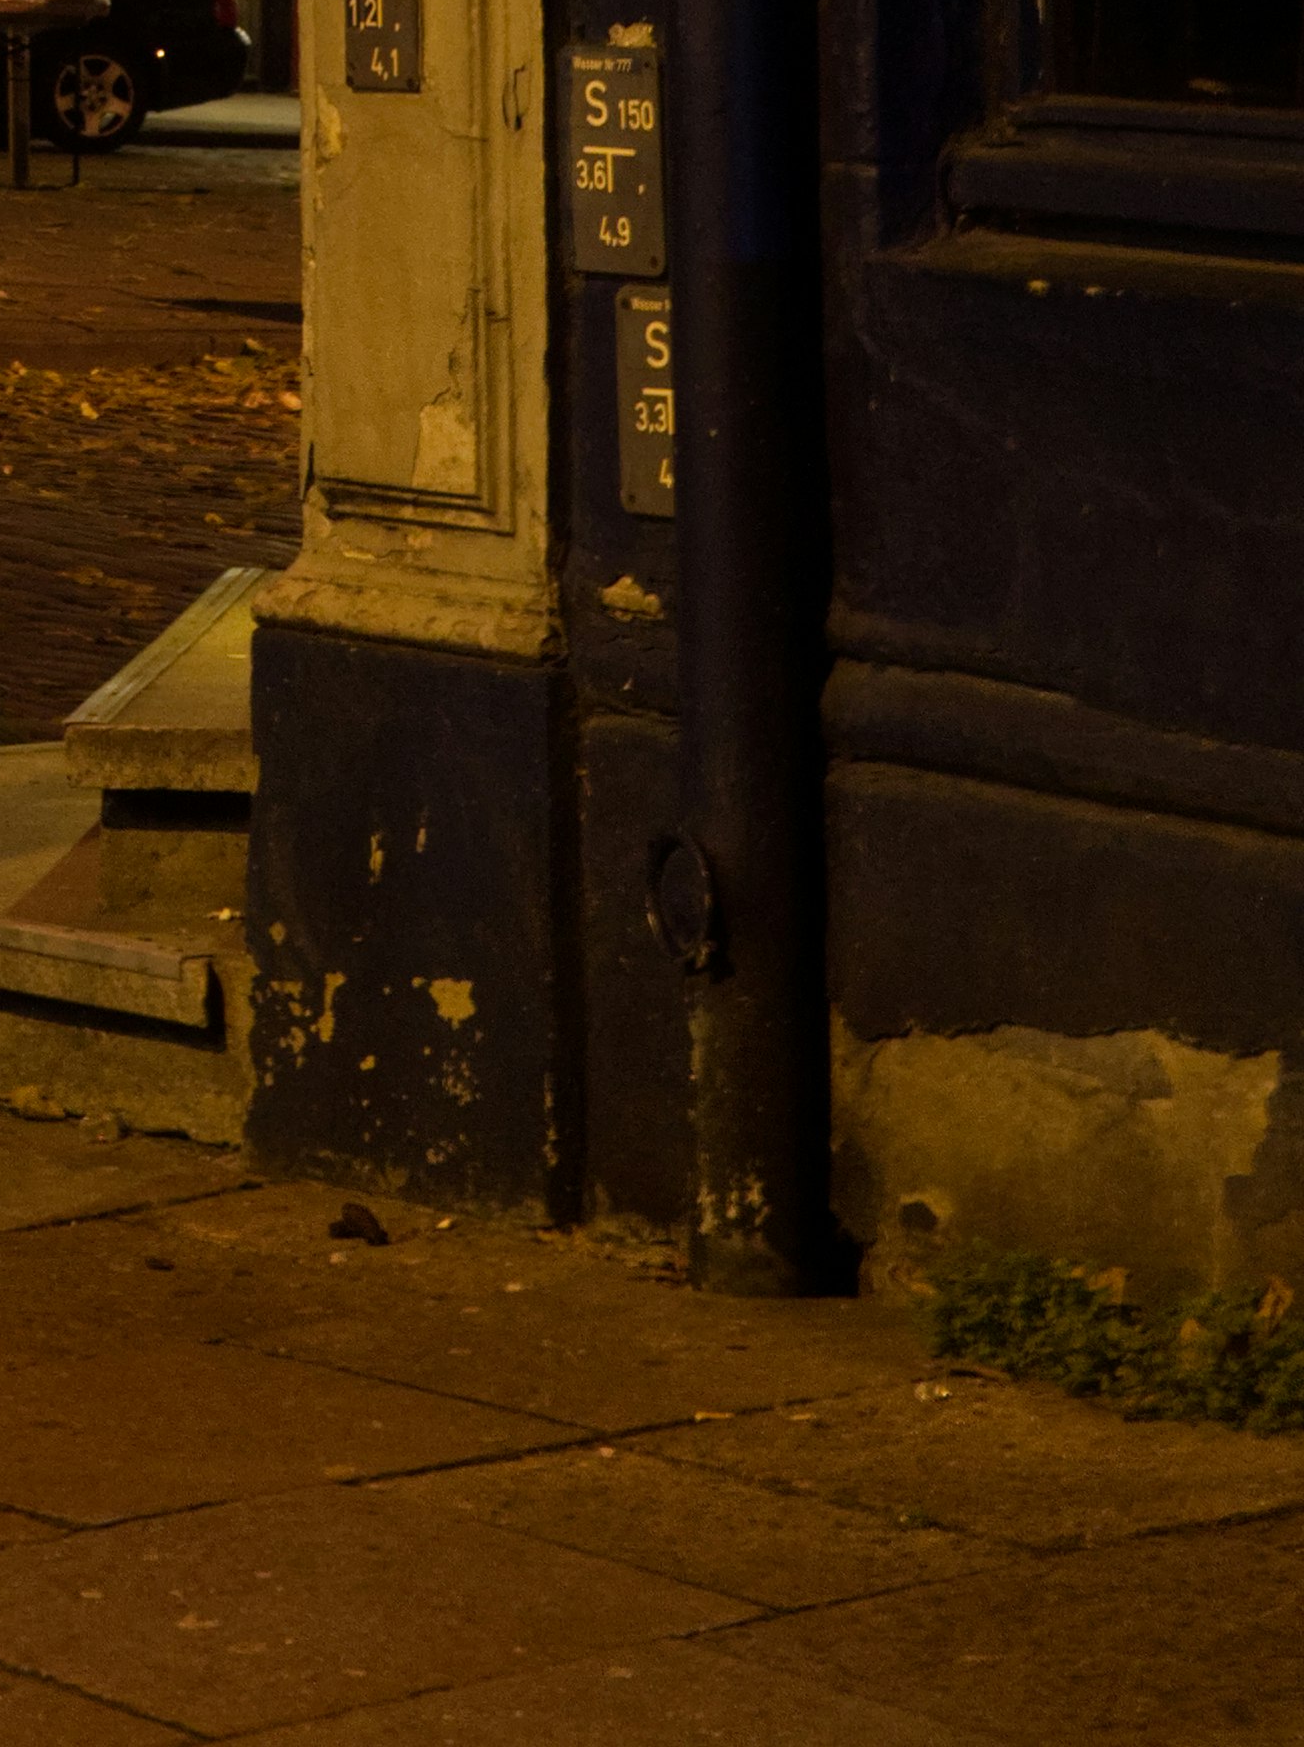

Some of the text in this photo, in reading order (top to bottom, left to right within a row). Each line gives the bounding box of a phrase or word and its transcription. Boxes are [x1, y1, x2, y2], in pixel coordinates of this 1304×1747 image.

[371, 47, 400, 81] 4,1
[585, 79, 655, 132] S 150
[599, 215, 633, 248] 4,9
[645, 320, 671, 369] S
